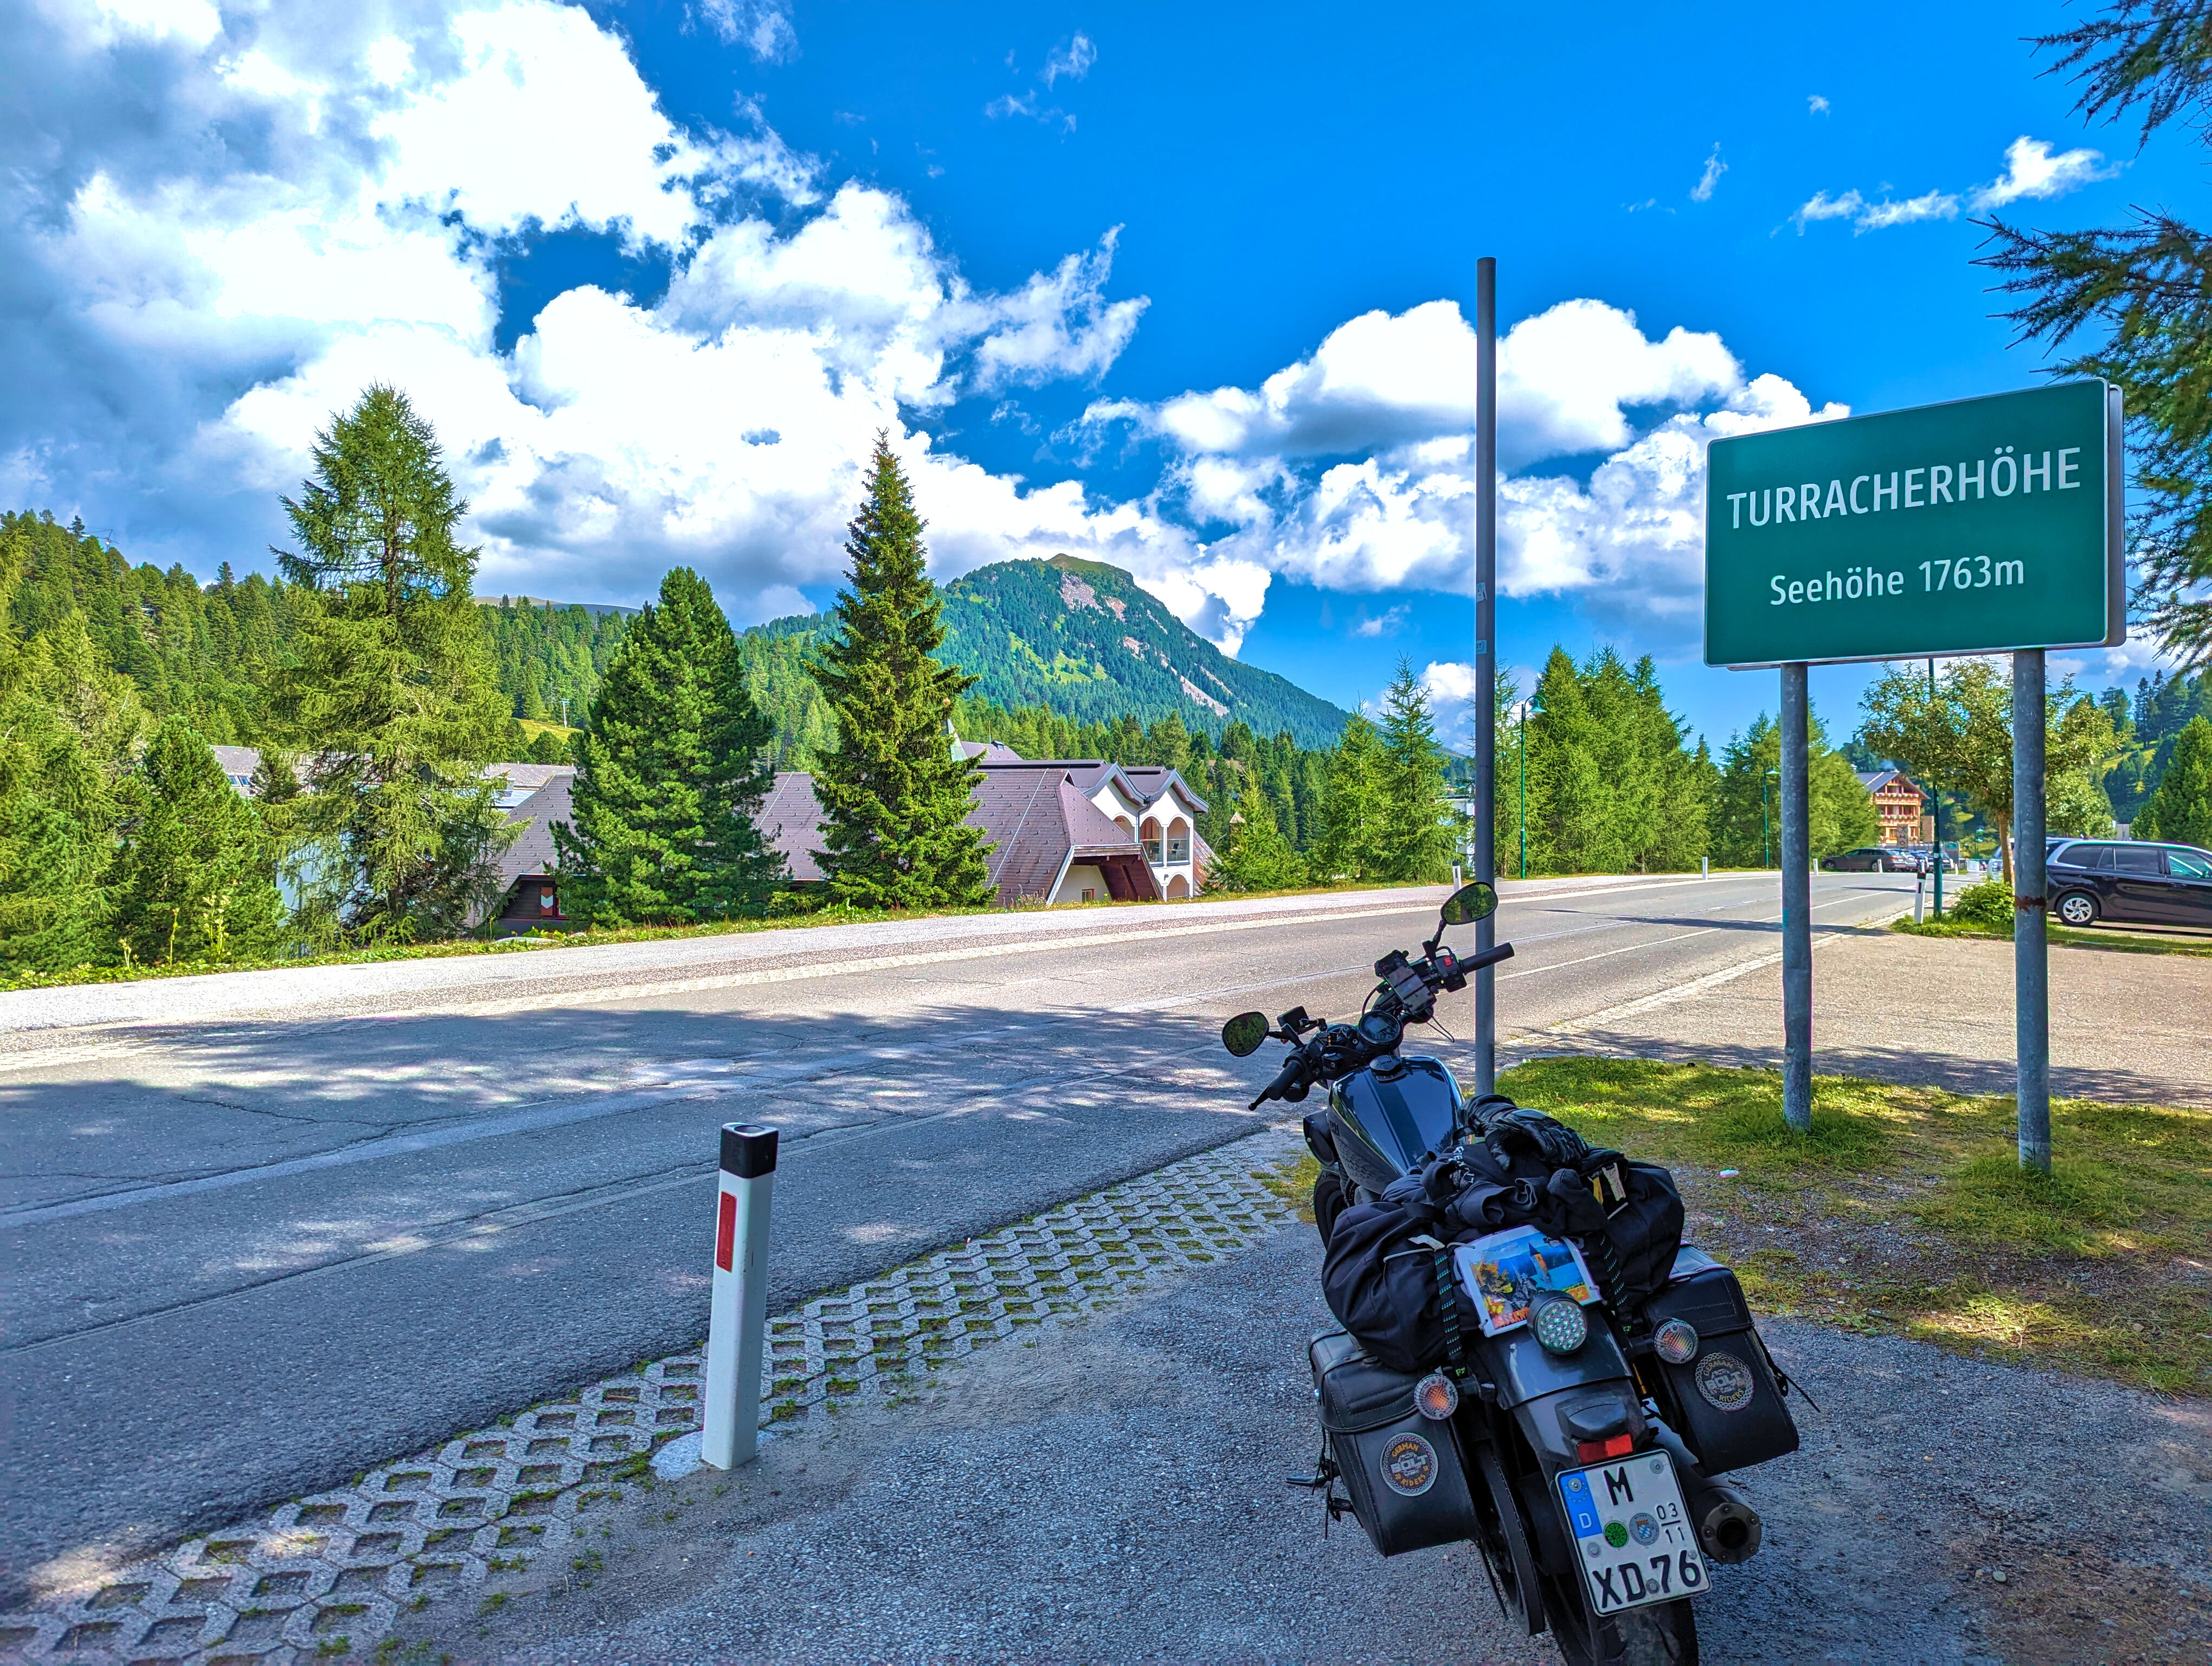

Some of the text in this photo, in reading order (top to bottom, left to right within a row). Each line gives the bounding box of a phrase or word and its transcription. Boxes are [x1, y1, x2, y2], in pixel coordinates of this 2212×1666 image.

[1727, 445, 2081, 529] TURRACHERHÖHE
[1770, 555, 2024, 606] Seehöhe 1763m
[1705, 1372, 1741, 1390] BOLT
[1719, 1388, 1744, 1402] RIDERS
[1392, 1443, 1419, 1458] GERMAN
[1390, 1454, 1428, 1473] BOLT
[1400, 1475, 1426, 1486] RIDERS
[1603, 1466, 1634, 1505] M
[1656, 1503, 1678, 1520] 03
[1578, 1513, 1592, 1529] D
[1665, 1526, 1685, 1544] 11
